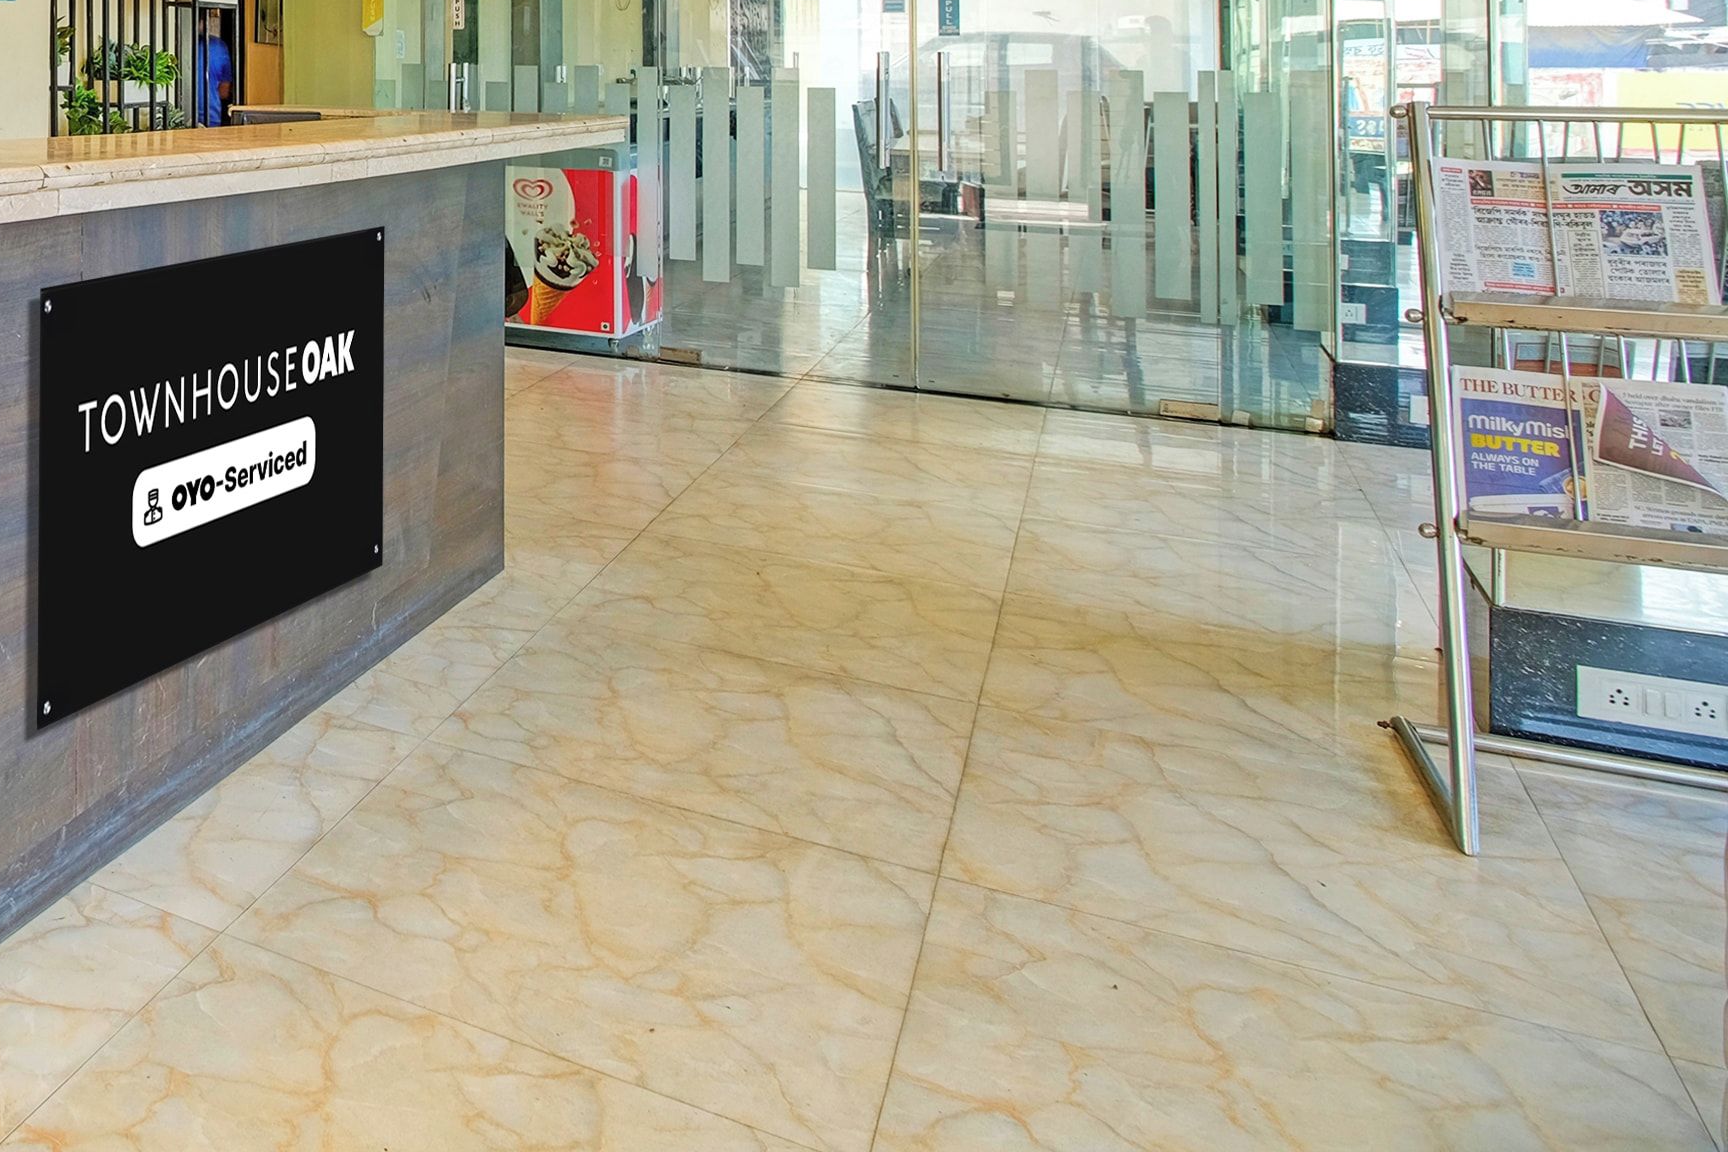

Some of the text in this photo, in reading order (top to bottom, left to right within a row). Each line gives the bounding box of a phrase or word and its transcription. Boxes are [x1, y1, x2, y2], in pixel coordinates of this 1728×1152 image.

[945, 0, 953, 25] PULL
[1627, 180, 1693, 197] অসম
[517, 202, 548, 210] KWALITY
[78, 329, 355, 453] TOWNHOUSE OAK
[1460, 378, 1500, 393] THE
[1502, 380, 1578, 403] BUTTER
[1471, 433, 1561, 458] BUTTER
[1471, 452, 1539, 468] ALWAYS ON
[1472, 460, 1536, 476] THE TABLE
[171, 440, 308, 512] OYO-Serviced
